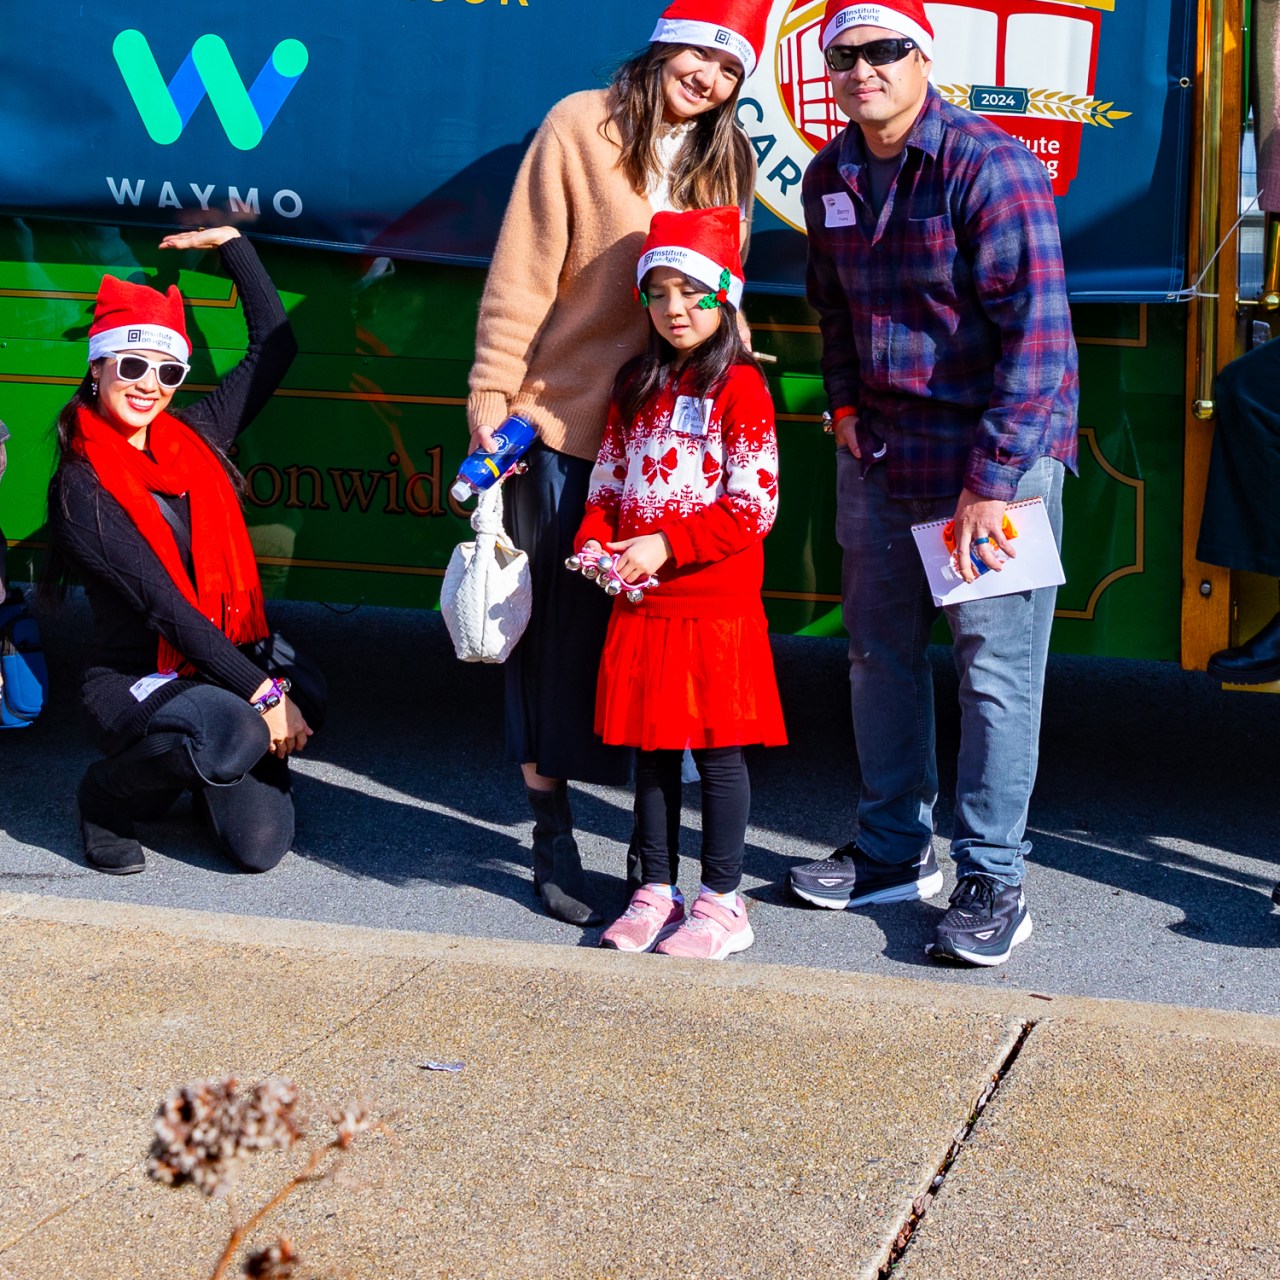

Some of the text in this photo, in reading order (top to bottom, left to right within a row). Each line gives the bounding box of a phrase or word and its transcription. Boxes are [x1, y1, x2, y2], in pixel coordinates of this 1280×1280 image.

[846, 7, 881, 17] Institute
[856, 14, 880, 23] Aging
[980, 93, 1016, 107] 2024
[104, 176, 304, 219] WAYMO
[228, 444, 480, 519] onwide
